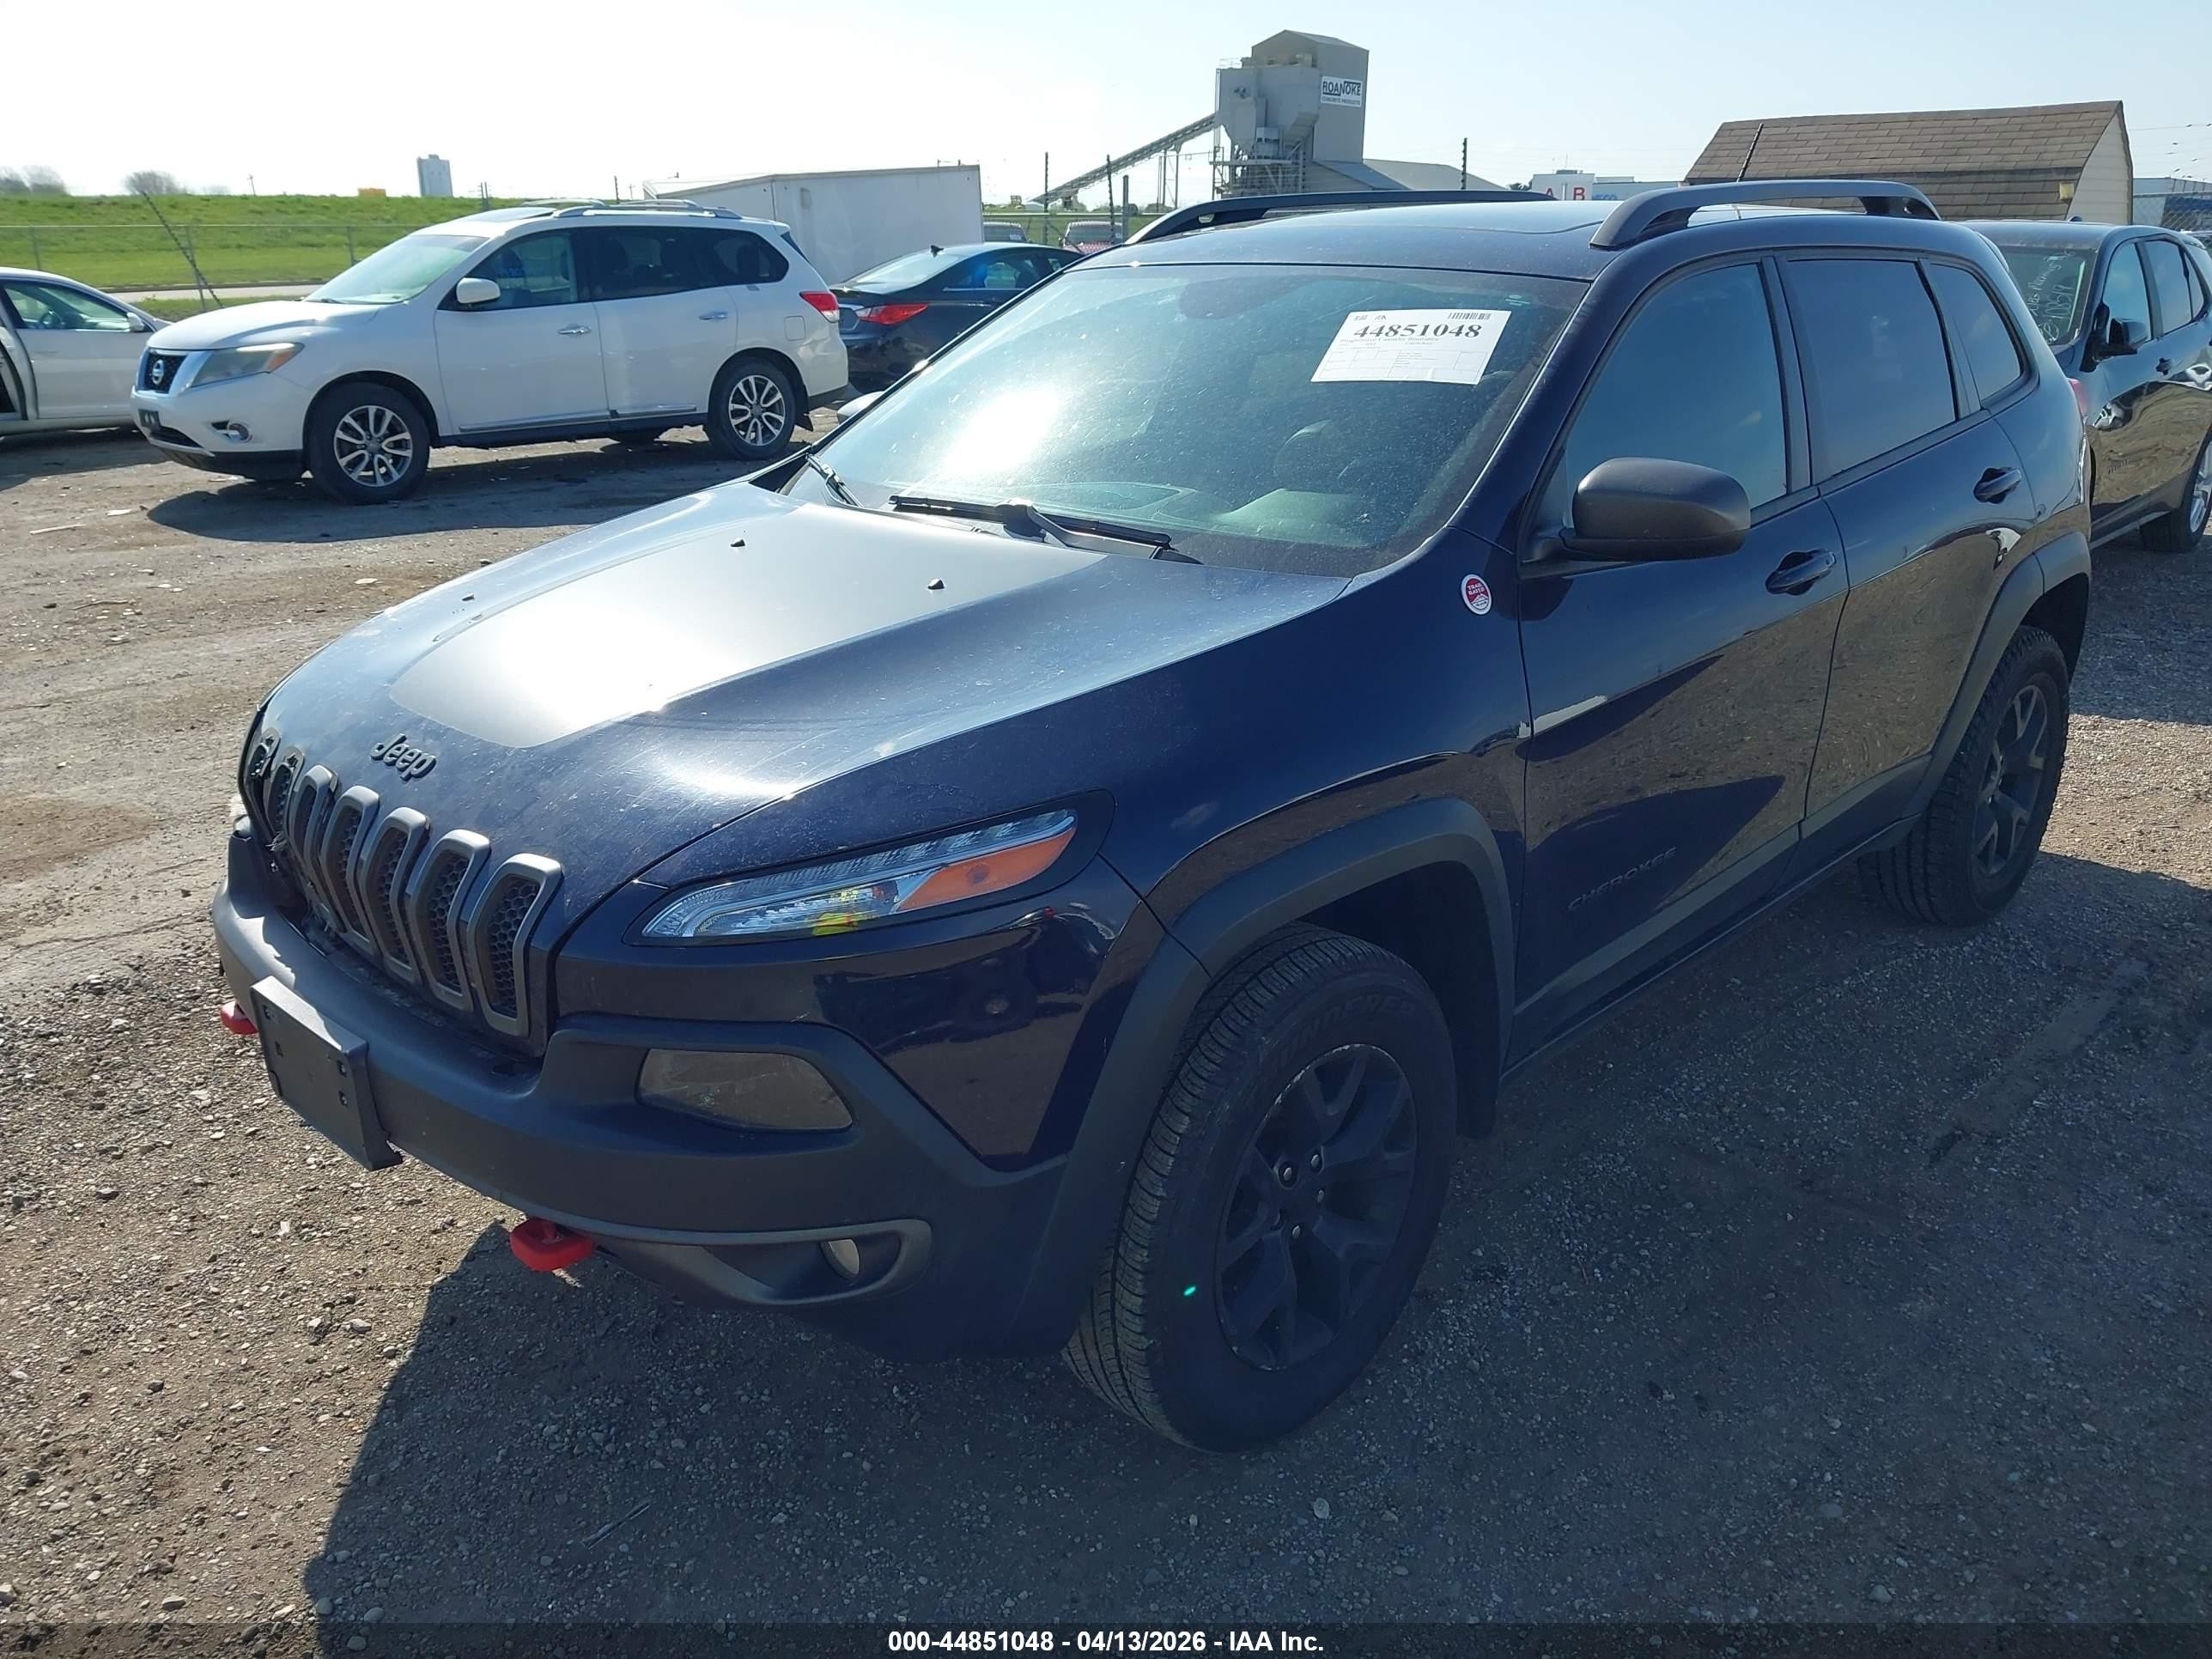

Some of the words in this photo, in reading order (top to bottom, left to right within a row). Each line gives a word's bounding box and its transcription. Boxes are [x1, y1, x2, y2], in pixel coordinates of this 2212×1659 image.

[1322, 81, 1361, 96] ROANOKE
[1546, 188, 1553, 198] A
[1574, 187, 1585, 201] B
[1353, 324, 1482, 338] 44851048
[370, 732, 437, 782] Jeep
[1567, 846, 1677, 913] CHEROKEE
